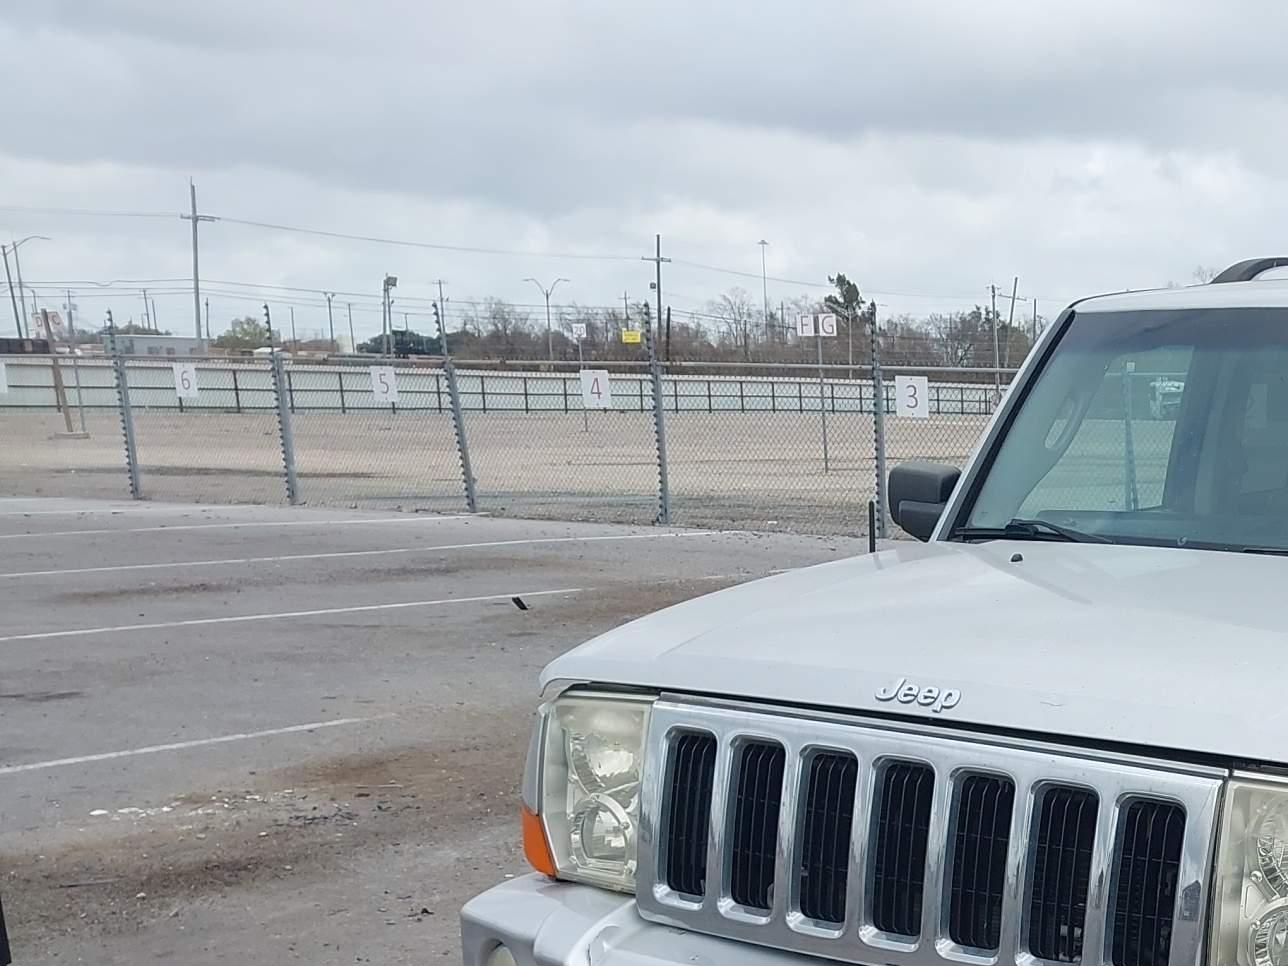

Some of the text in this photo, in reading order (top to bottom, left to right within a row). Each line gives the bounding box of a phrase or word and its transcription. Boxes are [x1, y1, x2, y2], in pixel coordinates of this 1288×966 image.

[800, 315, 835, 335] F G
[180, 370, 191, 390] 6
[379, 373, 389, 394] 5
[590, 378, 602, 400] 4
[906, 384, 919, 409] 3
[874, 677, 962, 714] Jeep
